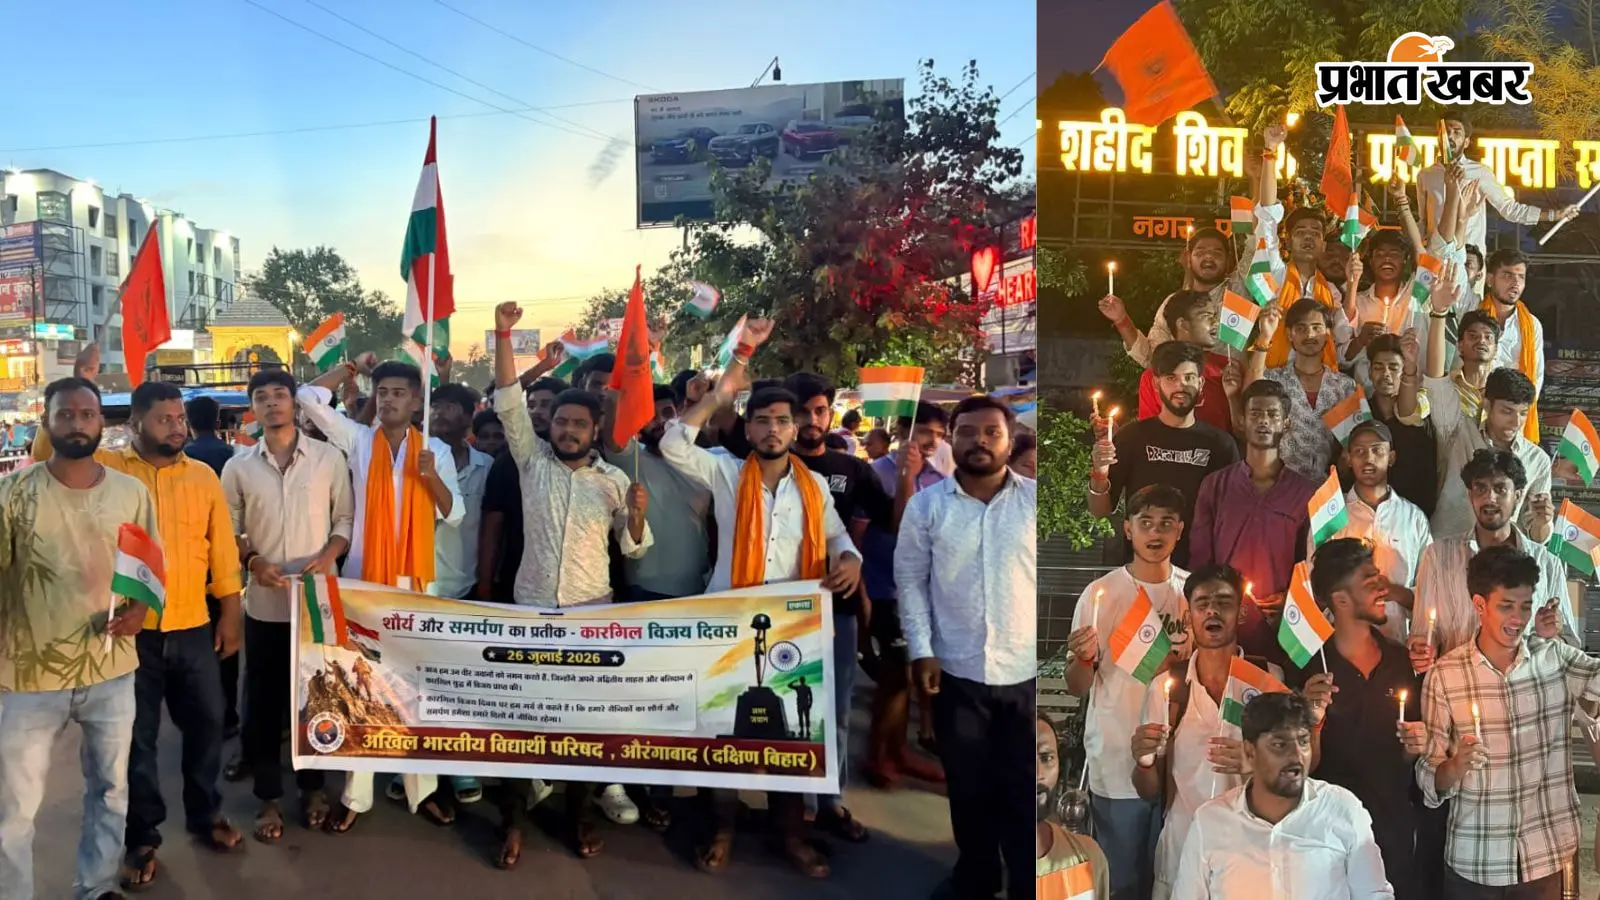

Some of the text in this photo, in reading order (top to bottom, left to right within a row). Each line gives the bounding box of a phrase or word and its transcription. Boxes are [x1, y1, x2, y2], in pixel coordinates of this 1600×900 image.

[1058, 107, 1158, 174] शहीद
[1172, 110, 1249, 178] शिव
[1132, 216, 1195, 239] नगर
[998, 270, 1037, 306] HEAR
[383, 613, 415, 631] शौर्य
[419, 617, 443, 634] और
[449, 618, 504, 637] समर्पण
[509, 625, 526, 638] का
[530, 623, 566, 639] प्रतीक
[580, 621, 644, 640] कारगिल
[648, 621, 692, 640] विजय
[697, 621, 738, 640] दिवस
[507, 649, 601, 667] 26 जुलाई 2026
[461, 667, 472, 677] वीर
[495, 670, 505, 679] को
[506, 672, 522, 680] नमन
[524, 672, 540, 681] करते
[578, 674, 594, 683] अपने
[625, 675, 644, 683] साहस
[647, 674, 658, 683] और
[666, 702, 679, 712] और
[362, 730, 418, 751] अखिल
[422, 732, 486, 753] भारतीय
[490, 733, 547, 756] विद्यार्थी
[551, 736, 604, 759] परिषद
[621, 738, 698, 763] औरंगाबाद
[703, 744, 759, 767] (दक्षिण
